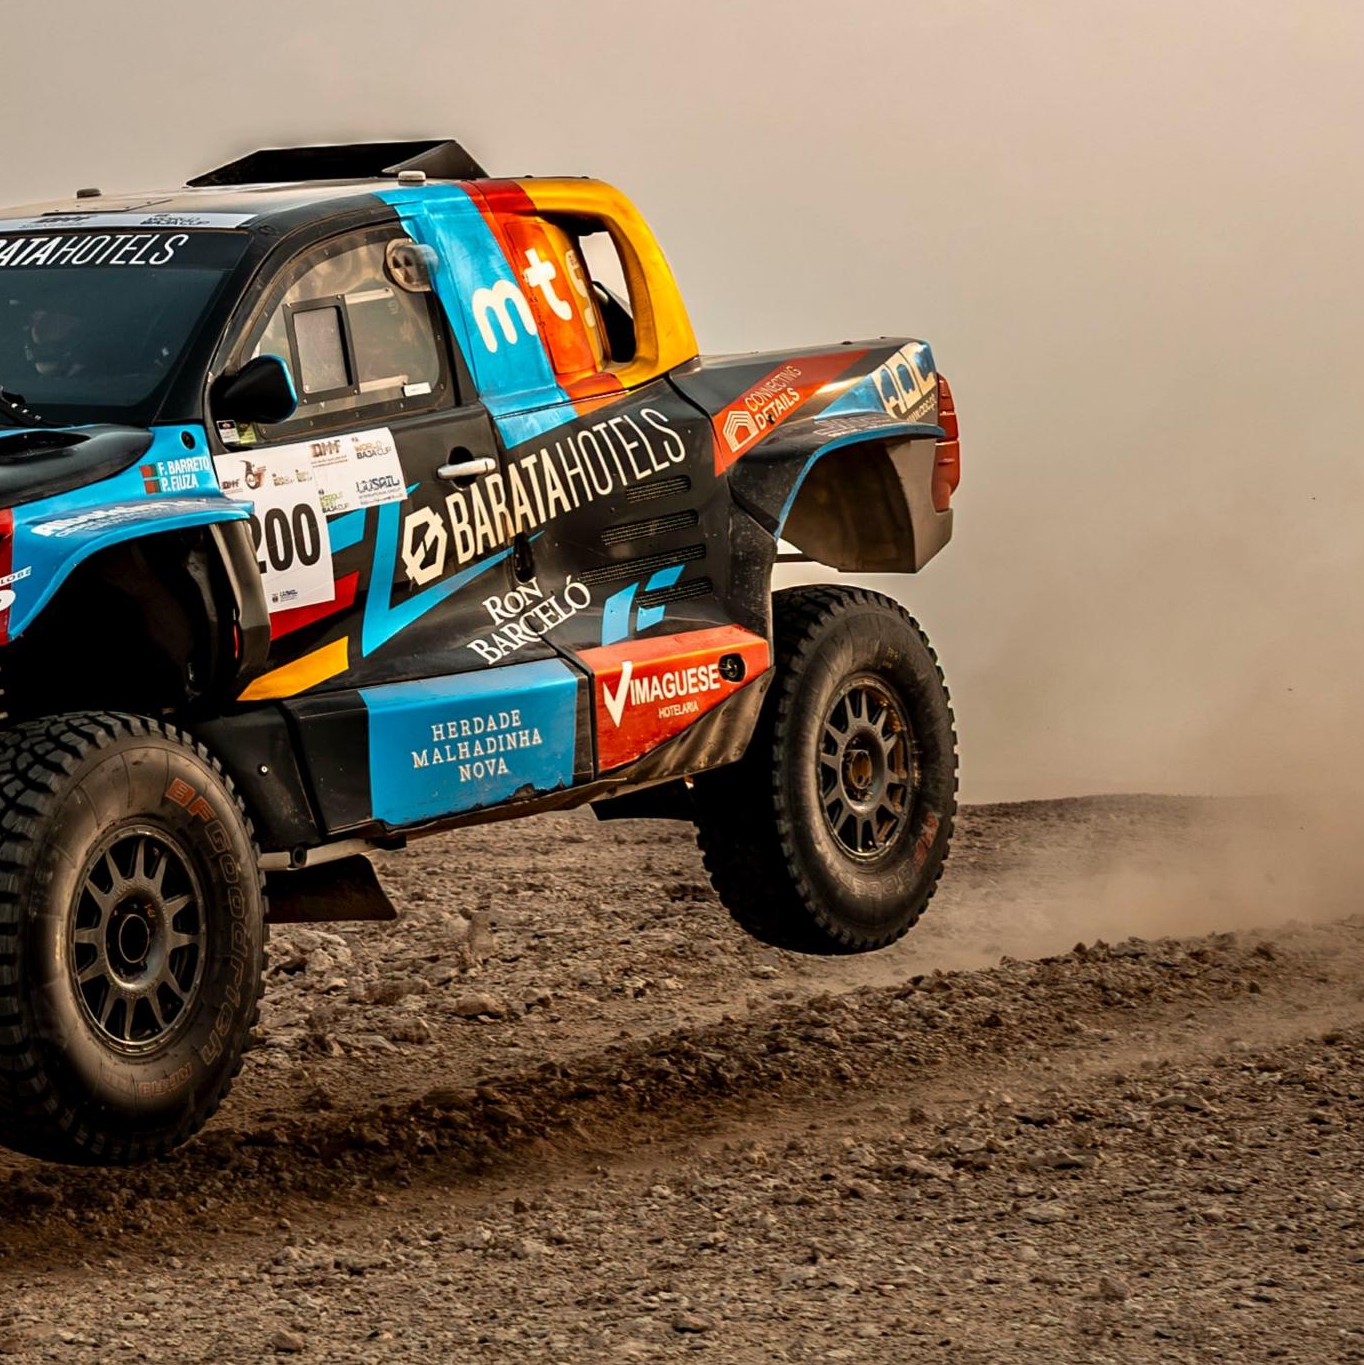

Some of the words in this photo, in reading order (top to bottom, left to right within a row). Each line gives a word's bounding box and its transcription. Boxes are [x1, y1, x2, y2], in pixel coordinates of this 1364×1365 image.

[744, 365, 802, 412] CONNECTING
[754, 387, 801, 431] DETAILS
[157, 462, 168, 476] F.
[167, 456, 210, 475] BARRETO
[161, 477, 172, 492] P.
[467, 574, 591, 666] BARCELÓ
[431, 709, 523, 742] HERDADE
[658, 700, 700, 720] HOTELARIA
[411, 727, 544, 769] MALHADINHA
[458, 757, 510, 783] NOVA
